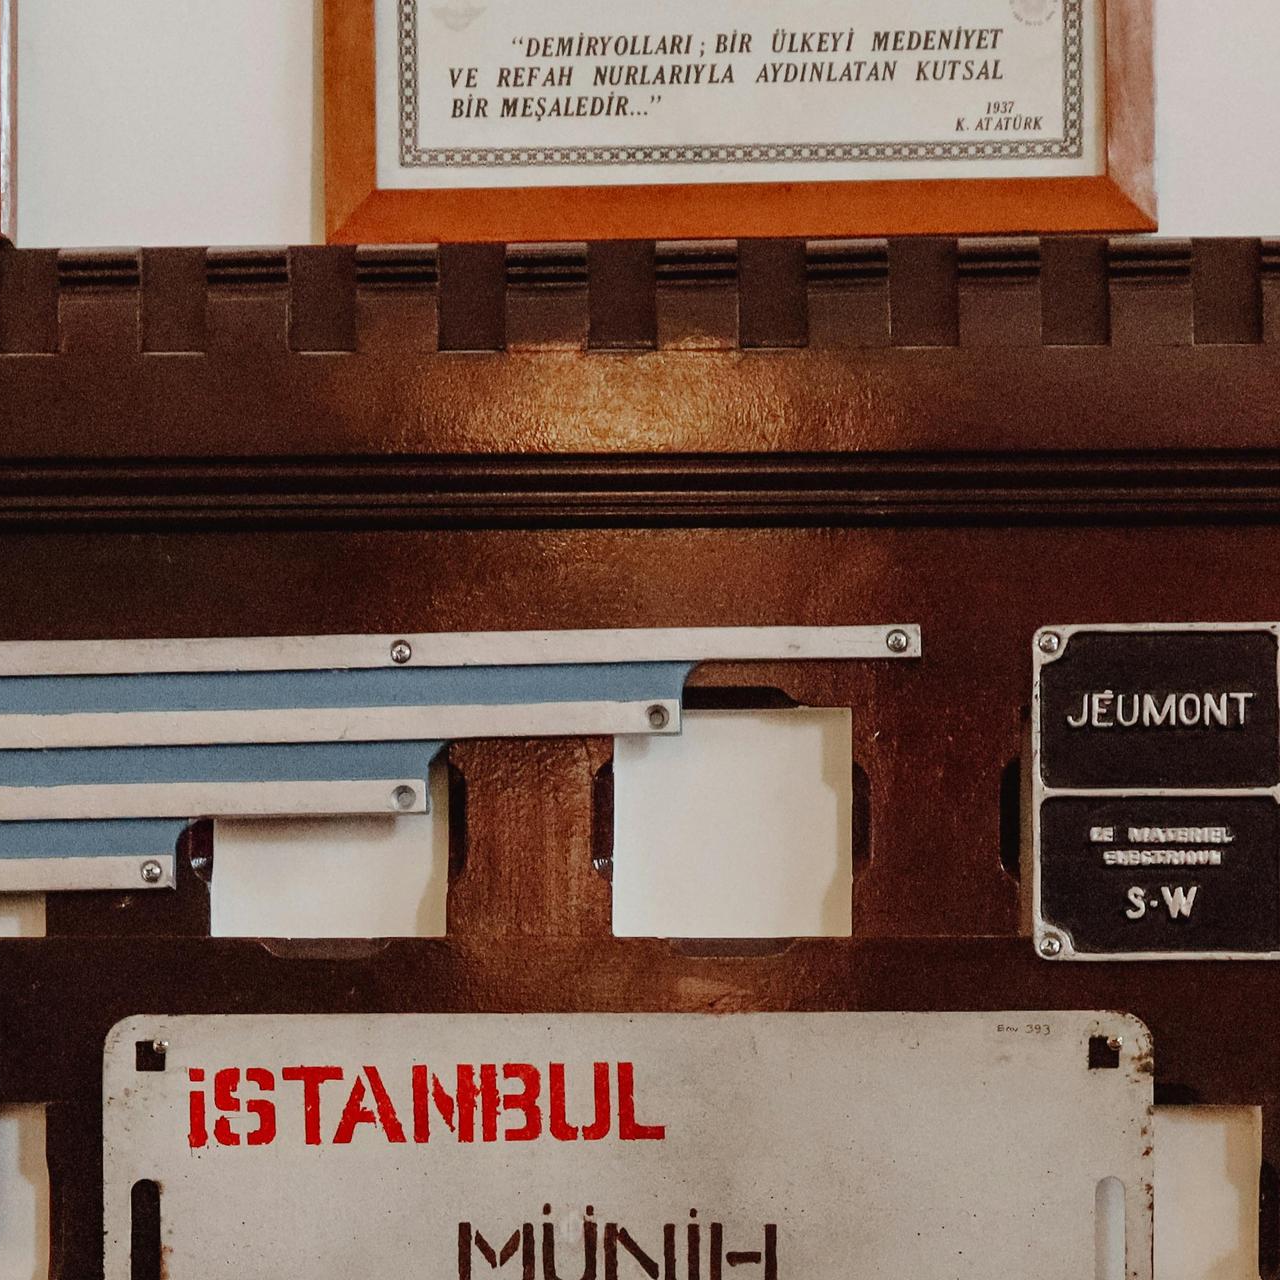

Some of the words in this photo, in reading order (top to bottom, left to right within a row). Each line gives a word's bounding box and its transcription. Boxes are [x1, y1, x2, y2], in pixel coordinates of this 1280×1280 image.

[715, 29, 753, 54] BİR
[772, 27, 855, 53] ÜLKEYİ
[871, 26, 1004, 51] MEDENİYET
[449, 67, 478, 88] VE
[496, 66, 573, 88] REFAH
[593, 63, 735, 86] NURLARIYLA
[756, 60, 897, 83] AYDINLATAN
[915, 60, 1004, 82] KUTSAL
[451, 93, 489, 118] BİR
[985, 101, 1015, 115] 1937
[955, 117, 970, 131] K.
[974, 114, 1044, 131] ATATÜRK
[1024, 1023, 1051, 1036] 393
